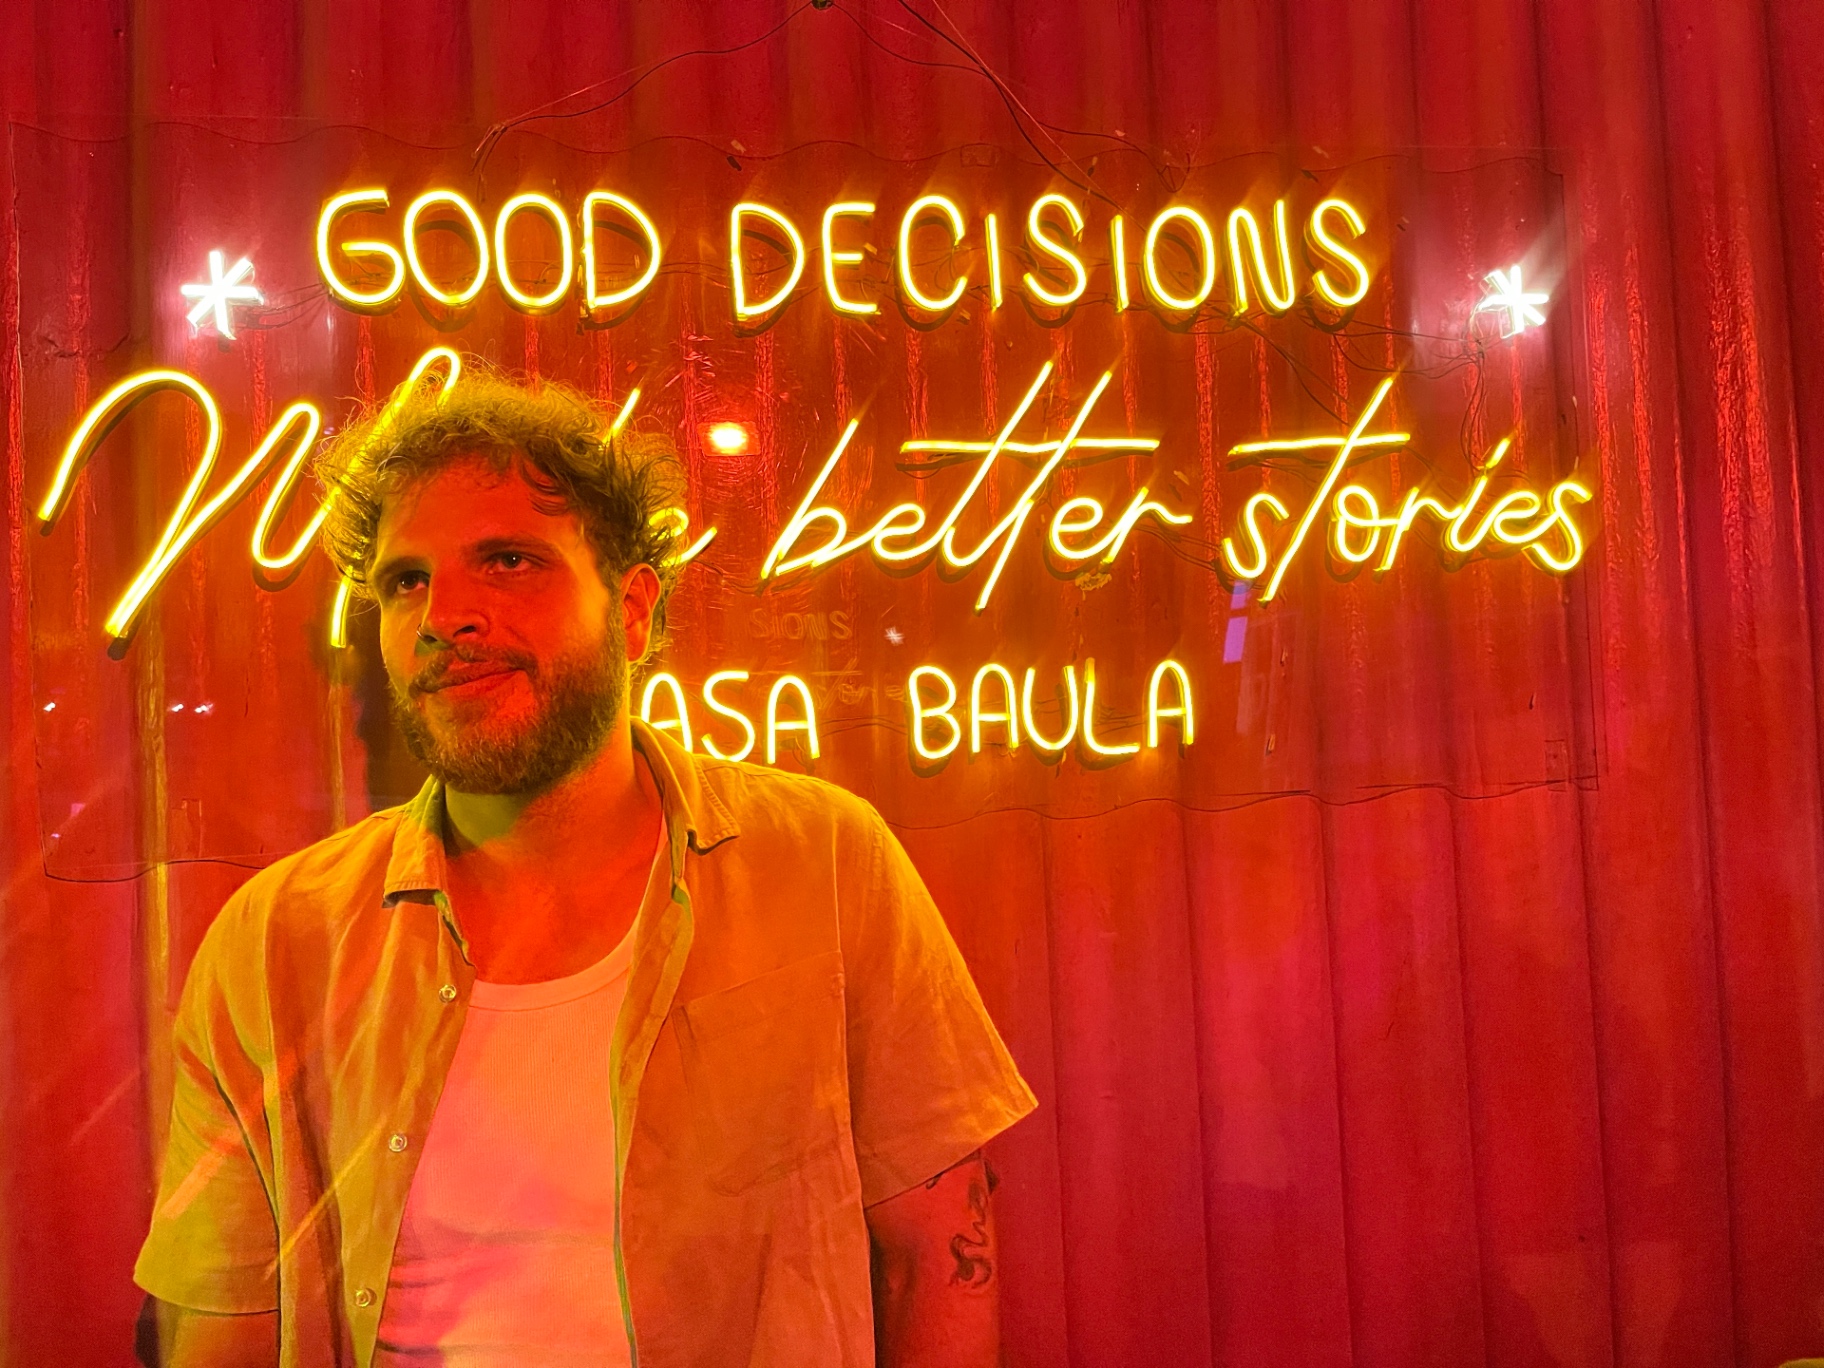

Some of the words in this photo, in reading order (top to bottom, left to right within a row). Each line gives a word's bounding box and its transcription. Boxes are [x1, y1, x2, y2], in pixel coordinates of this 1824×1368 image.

[315, 188, 663, 310] GOOD
[730, 193, 1371, 317] DECISIONS
[760, 360, 1193, 610] better
[1223, 377, 1594, 603] stories
[638, 669, 820, 764] ASA
[908, 658, 1195, 760] BAULA
